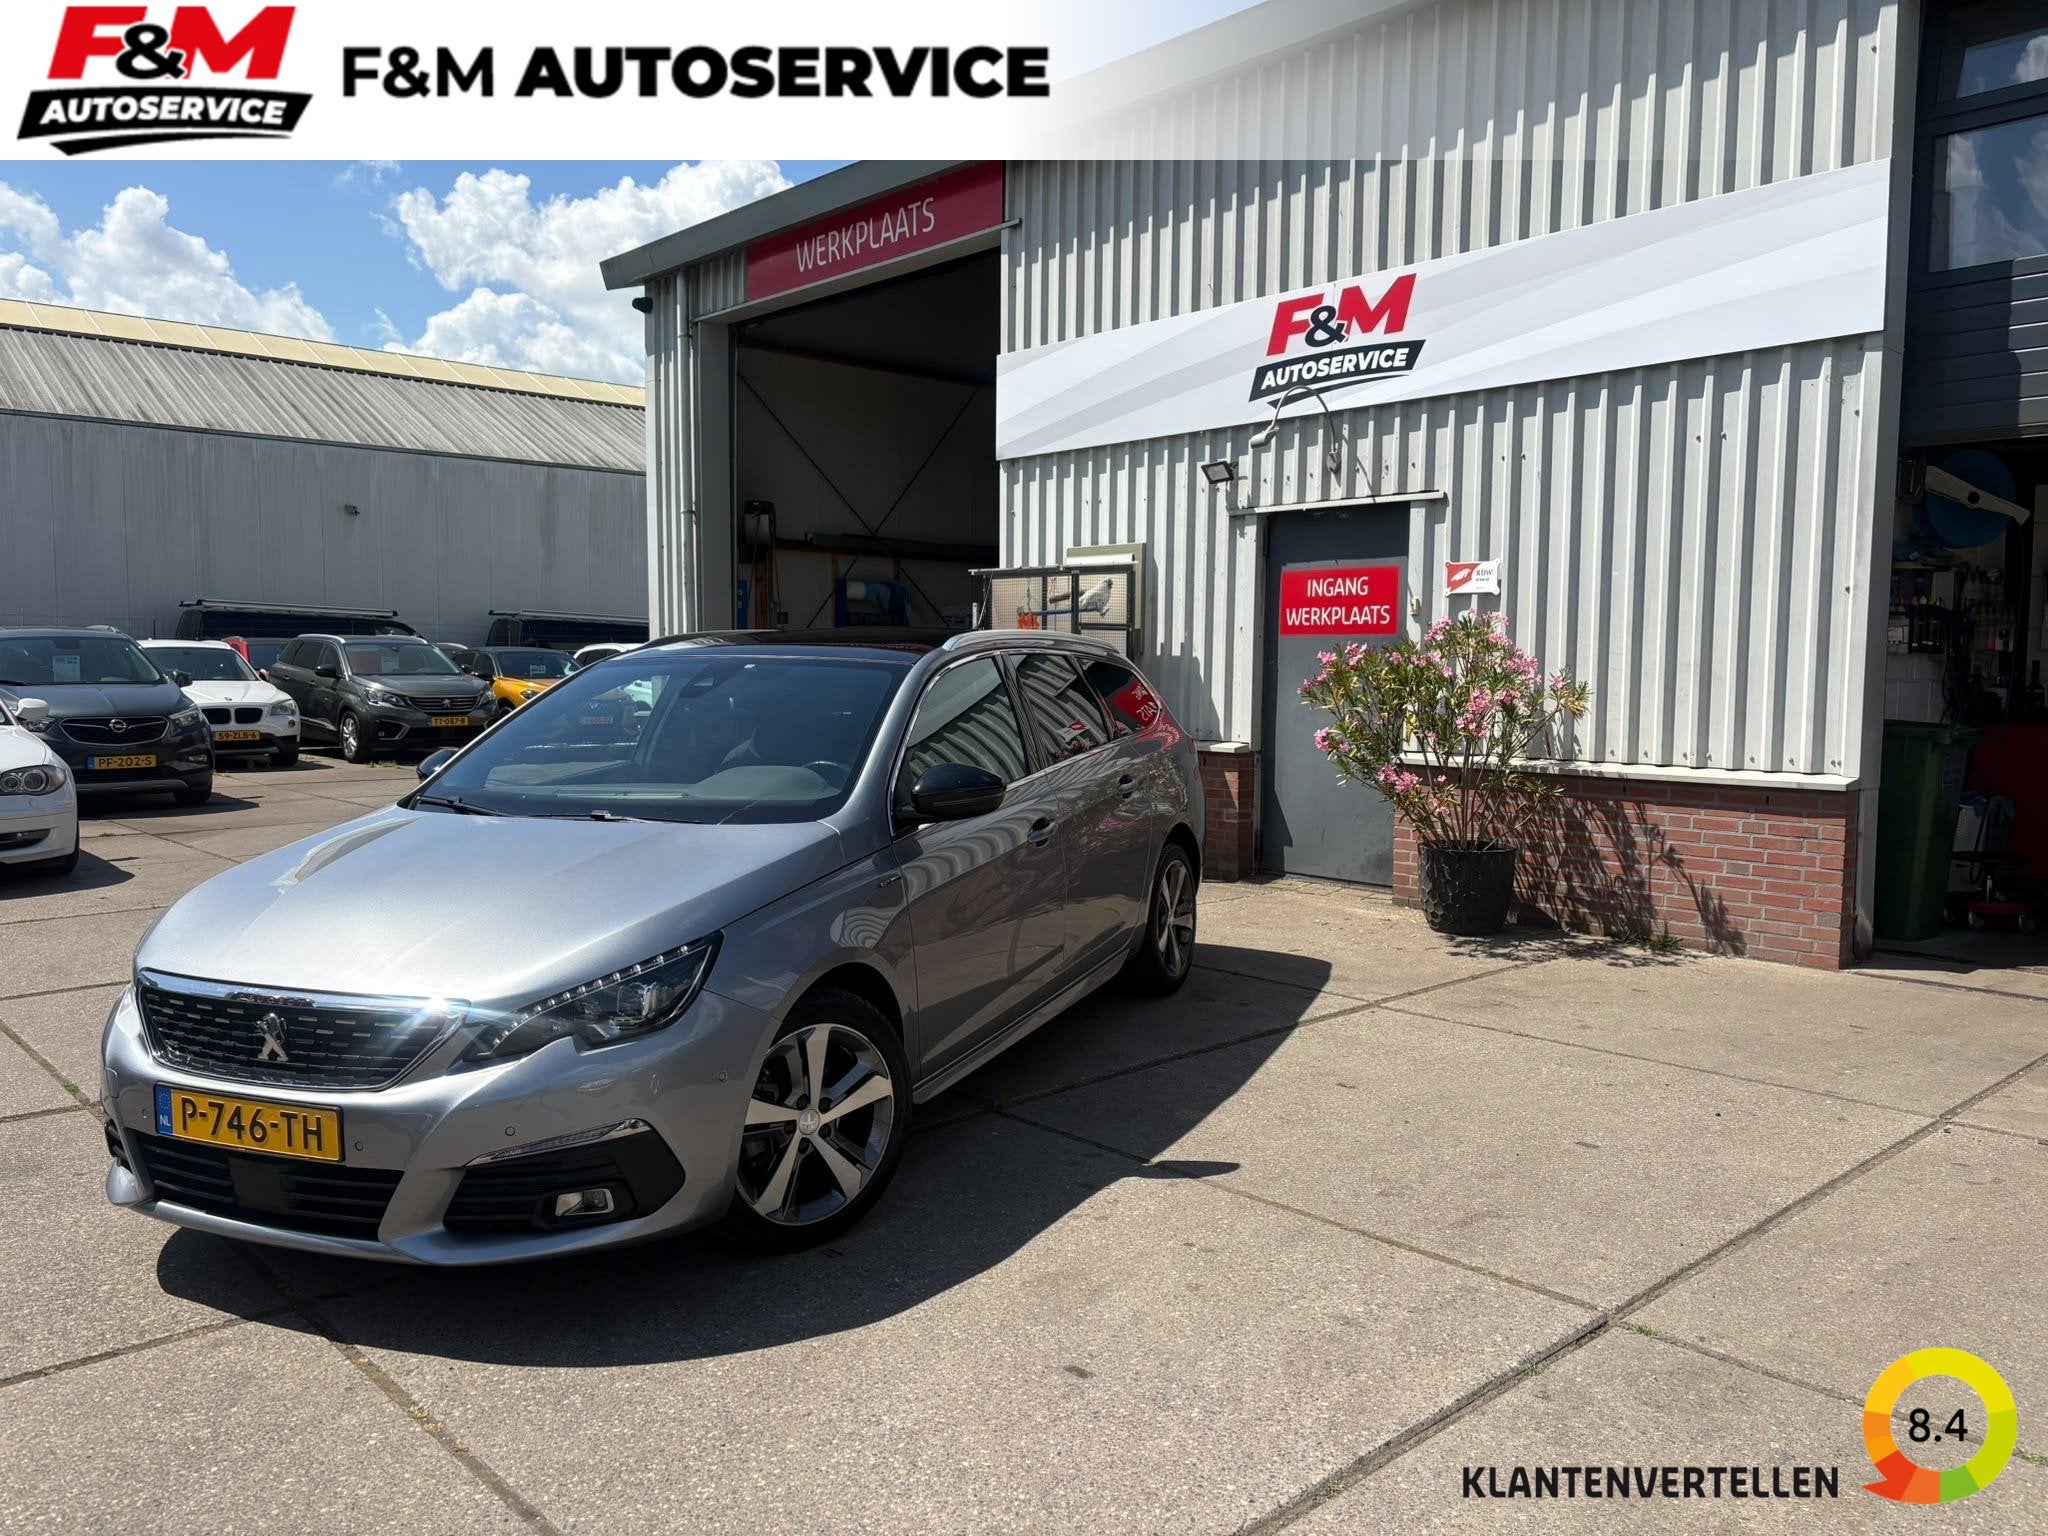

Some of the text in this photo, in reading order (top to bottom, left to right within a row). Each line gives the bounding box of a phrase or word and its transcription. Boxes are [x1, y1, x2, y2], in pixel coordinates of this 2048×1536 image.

[796, 197, 935, 273] WERKPLAATS
[1266, 273, 1417, 357] F&M
[1260, 347, 1410, 390] AUTOSERVICE
[1307, 576, 1369, 598] INGANG
[1285, 604, 1391, 626] WERKPLAATS
[98, 756, 153, 768] PF-202-S
[159, 1115, 172, 1127] NL
[180, 1095, 323, 1152] P-746-TH
